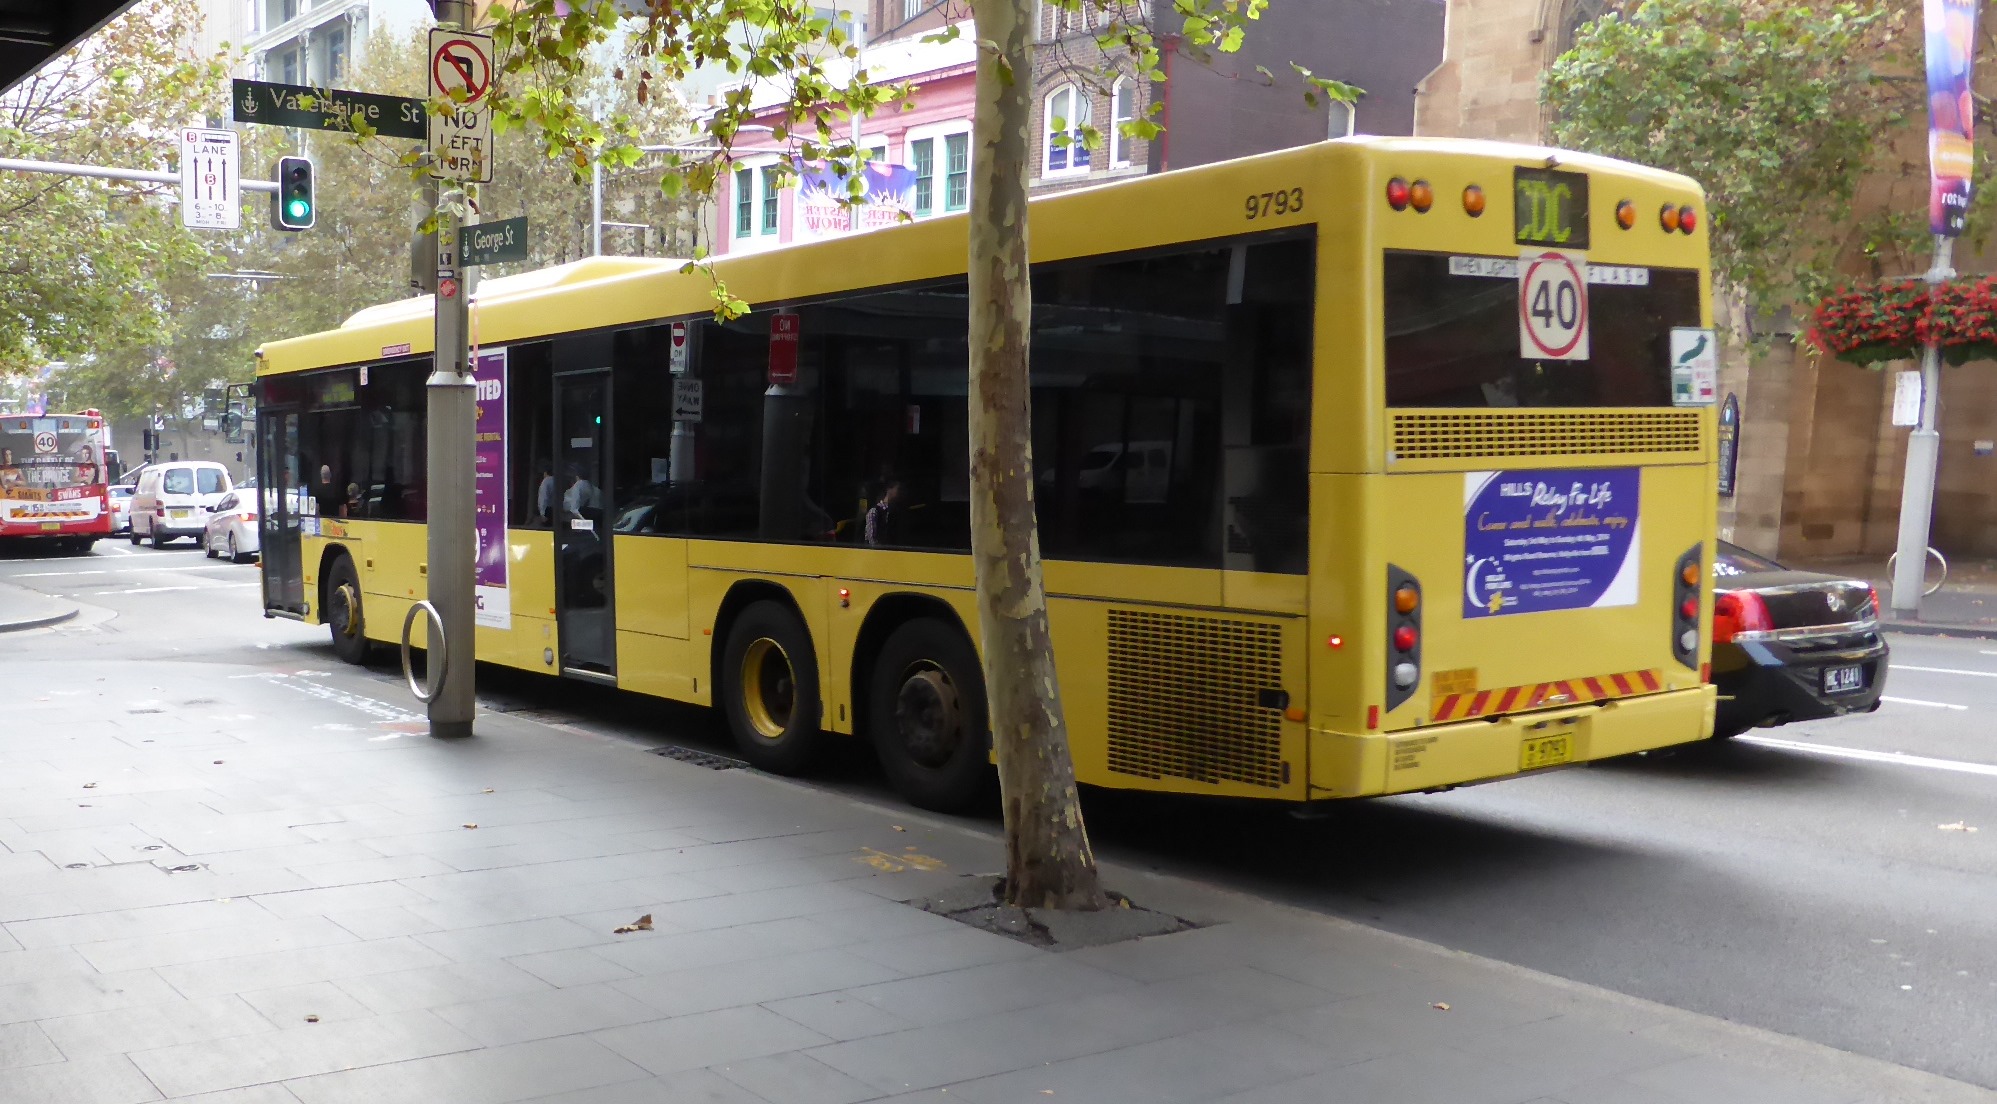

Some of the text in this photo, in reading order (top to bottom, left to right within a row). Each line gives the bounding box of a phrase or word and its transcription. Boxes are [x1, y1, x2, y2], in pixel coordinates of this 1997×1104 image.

[269, 87, 420, 123] Vaentine St
[443, 107, 477, 130] NO
[193, 144, 227, 155] LANE
[1245, 187, 1304, 220] 9793
[474, 224, 514, 253] George St
[1531, 279, 1577, 331] 40
[38, 437, 54, 447] 40
